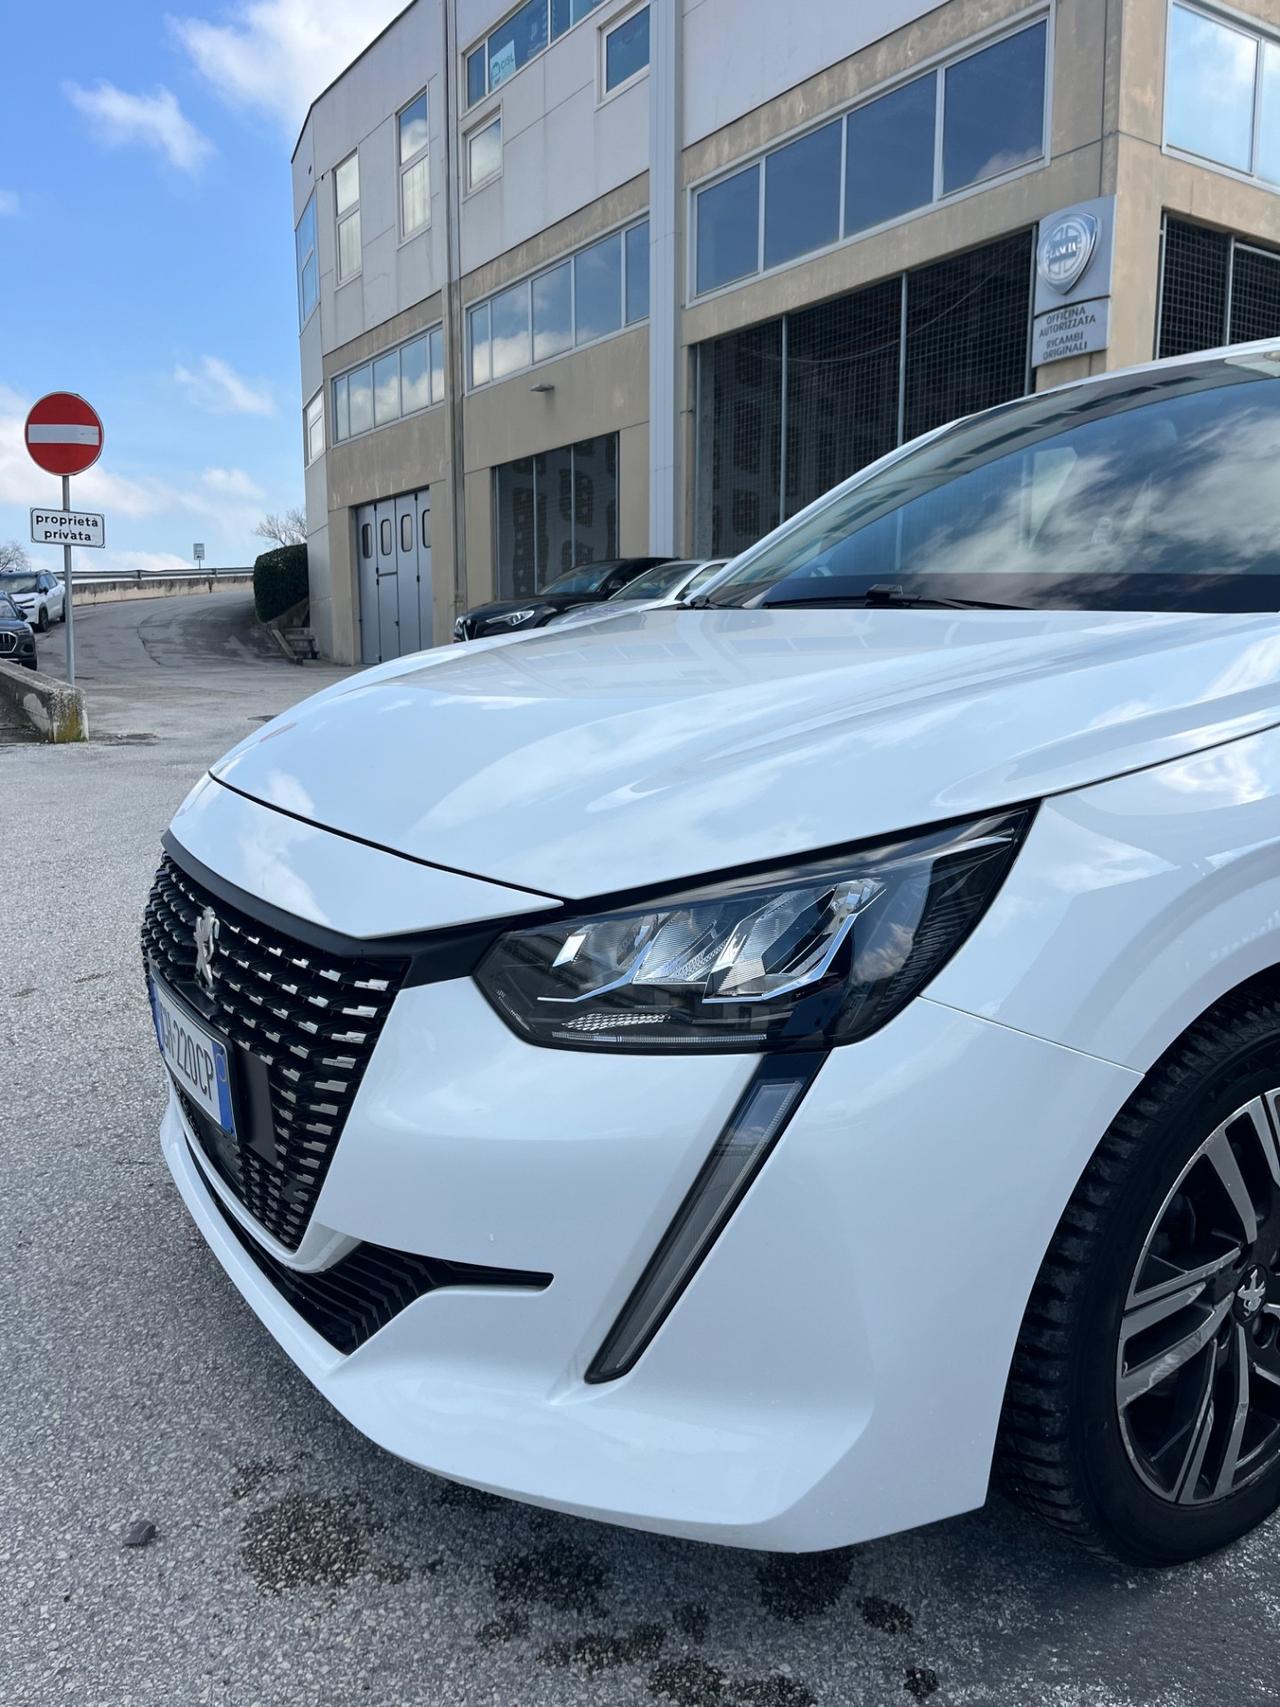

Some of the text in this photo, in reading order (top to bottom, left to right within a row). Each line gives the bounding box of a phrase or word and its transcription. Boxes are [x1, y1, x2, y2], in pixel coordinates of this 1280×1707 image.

[1046, 306, 1086, 325] OFFICINA
[1039, 314, 1096, 338] AUTORIZZATA
[1046, 331, 1084, 349] RICAMBI
[1042, 341, 1087, 361] ORIGINALI
[36, 515, 98, 527] proprietà
[44, 529, 92, 541] privata
